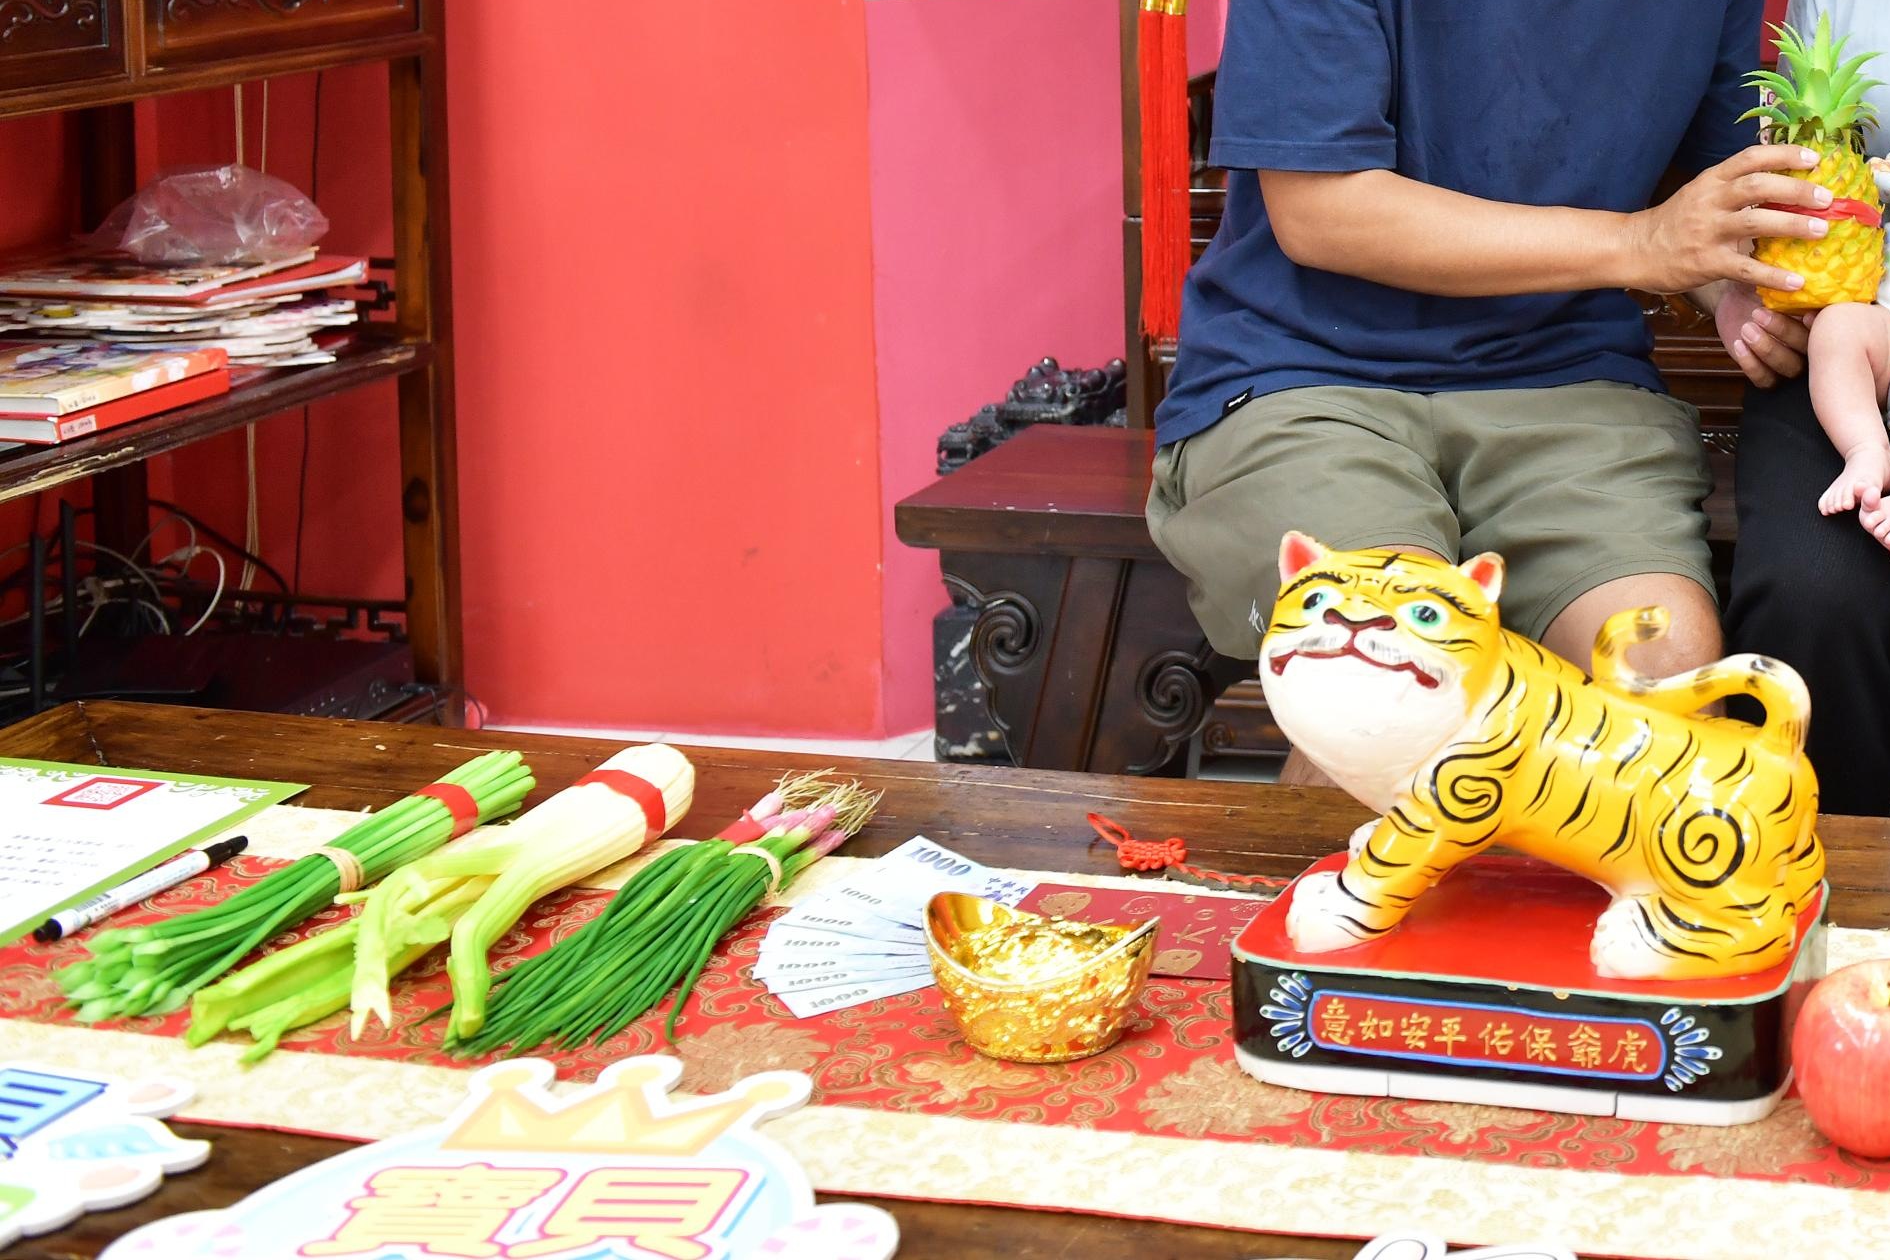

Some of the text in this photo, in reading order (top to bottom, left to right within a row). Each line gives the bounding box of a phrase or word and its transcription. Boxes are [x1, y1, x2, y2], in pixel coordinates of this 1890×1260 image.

[904, 845, 972, 876] 1000
[840, 887, 883, 906] 1000
[799, 913, 853, 927] 1000
[783, 938, 841, 948] 1000
[776, 959, 837, 971] 1000
[787, 972, 848, 987] 1000
[809, 988, 870, 1010] 1000
[296, 1161, 750, 1260] 寶貝
